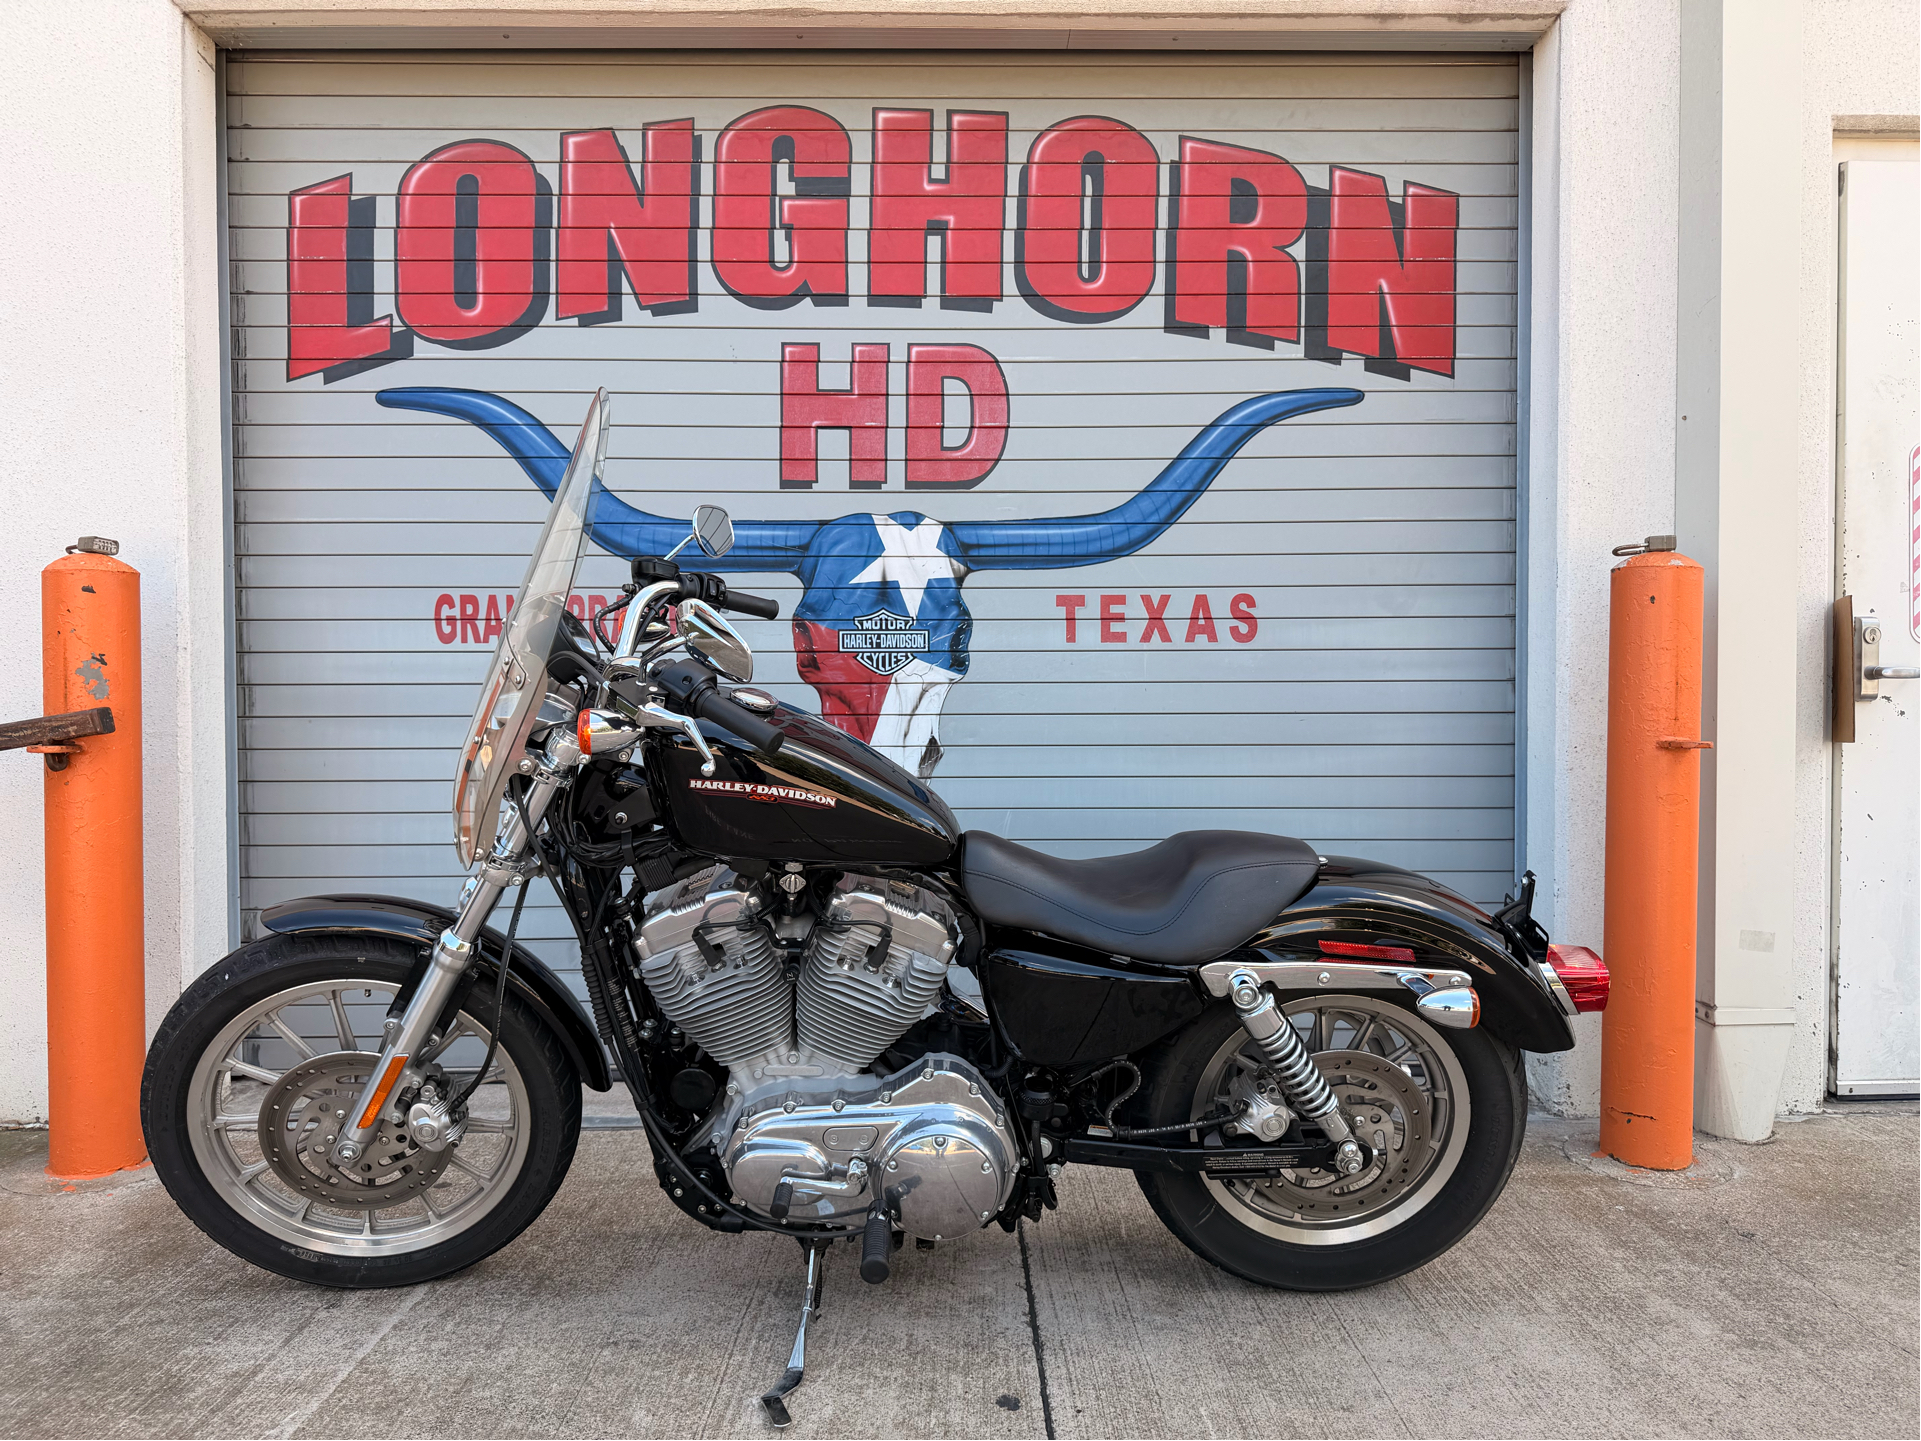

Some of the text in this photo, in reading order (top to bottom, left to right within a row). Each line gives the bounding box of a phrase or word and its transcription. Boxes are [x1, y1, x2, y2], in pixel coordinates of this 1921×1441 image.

[286, 104, 1460, 383] LONGHORN
[780, 342, 1010, 489] HD
[434, 593, 515, 645] GRA
[862, 613, 906, 630] MOTOR
[1055, 592, 1259, 644] TEXAS
[843, 634, 924, 648] HARLEY-DAVIDSON
[863, 652, 906, 672] CYCLES
[690, 779, 836, 807] HARLEY-DAVIDSON
